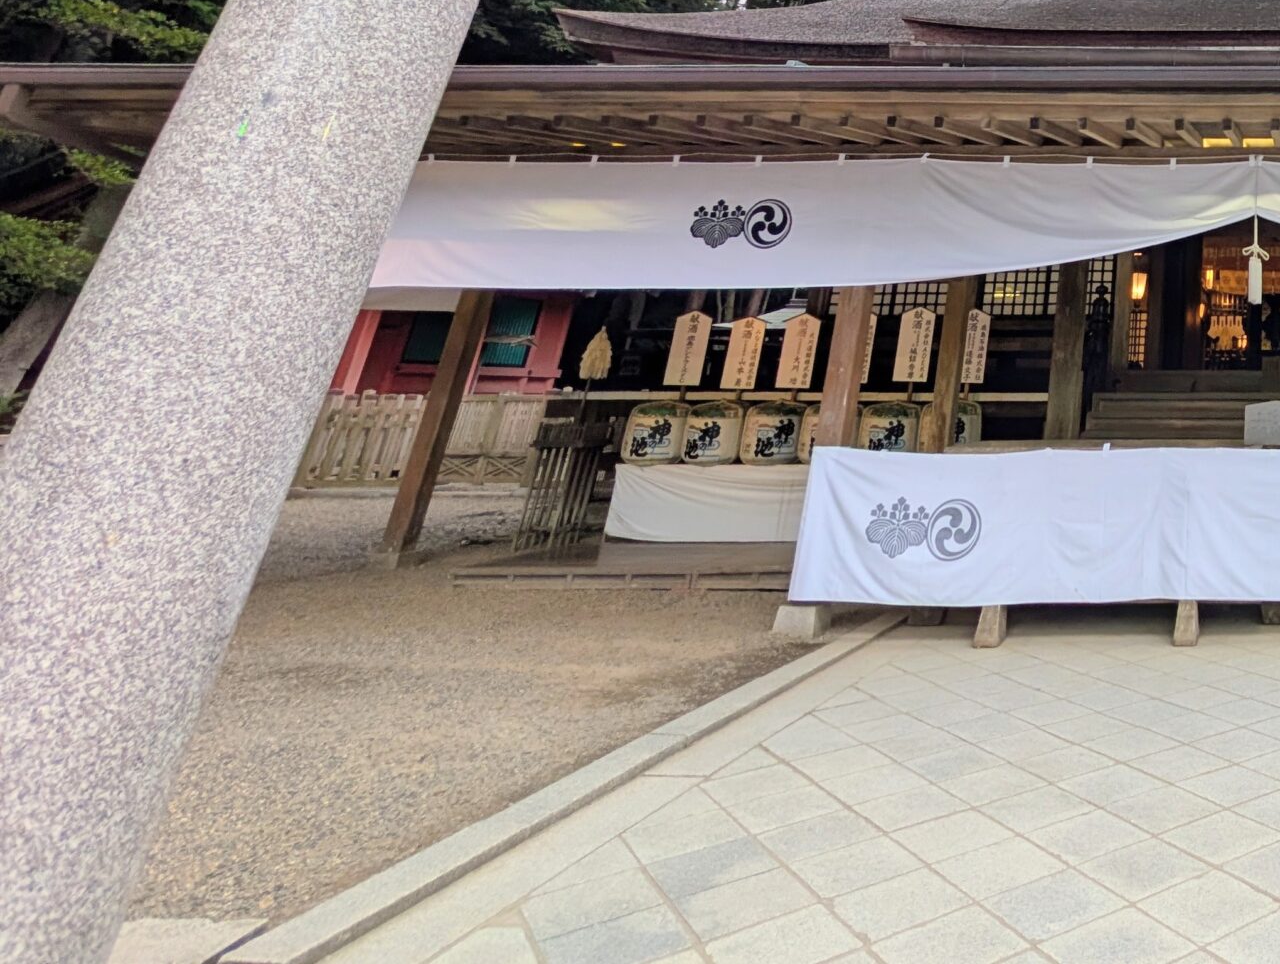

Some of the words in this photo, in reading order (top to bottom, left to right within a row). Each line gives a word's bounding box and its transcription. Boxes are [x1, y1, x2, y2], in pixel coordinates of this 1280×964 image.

[911, 309, 924, 330] 献酒
[967, 312, 979, 331] 献酒
[630, 417, 671, 457] 神の池
[684, 421, 720, 459] 神の池
[754, 418, 795, 457] 神の池
